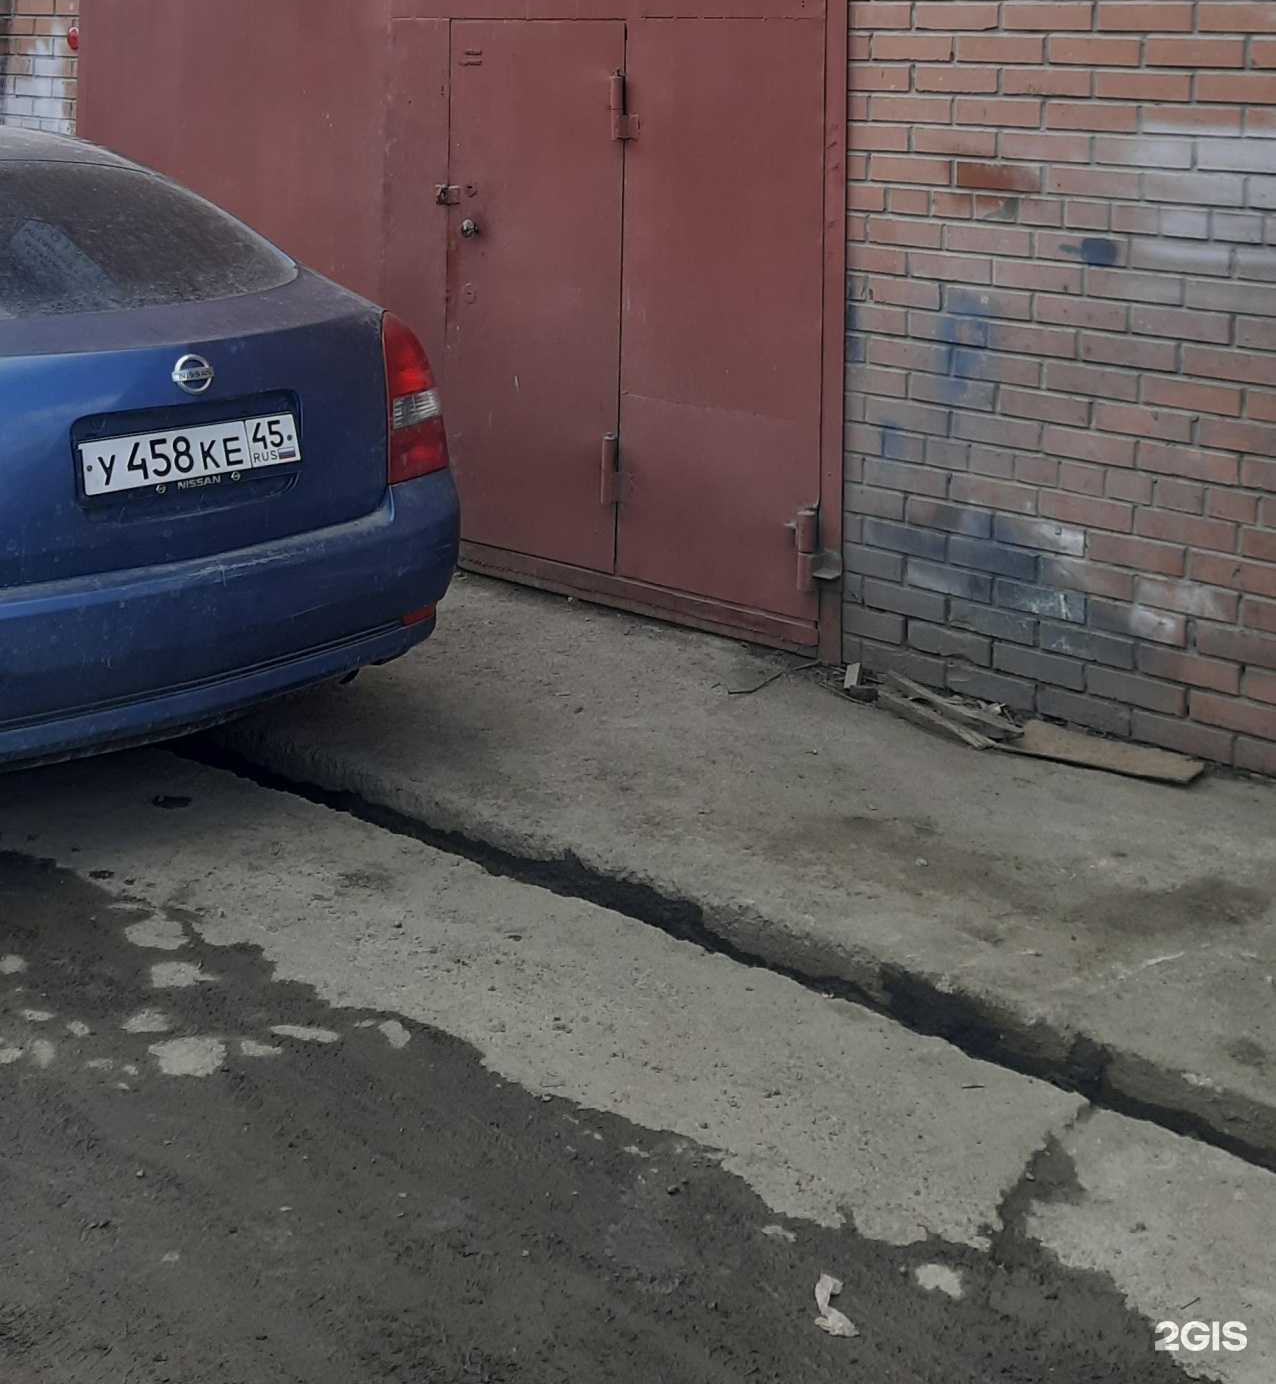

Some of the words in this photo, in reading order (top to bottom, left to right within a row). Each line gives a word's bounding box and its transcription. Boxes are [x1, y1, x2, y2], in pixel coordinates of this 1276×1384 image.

[251, 419, 284, 450] 45
[253, 451, 278, 464] RUS
[177, 475, 221, 490] NISSAN
